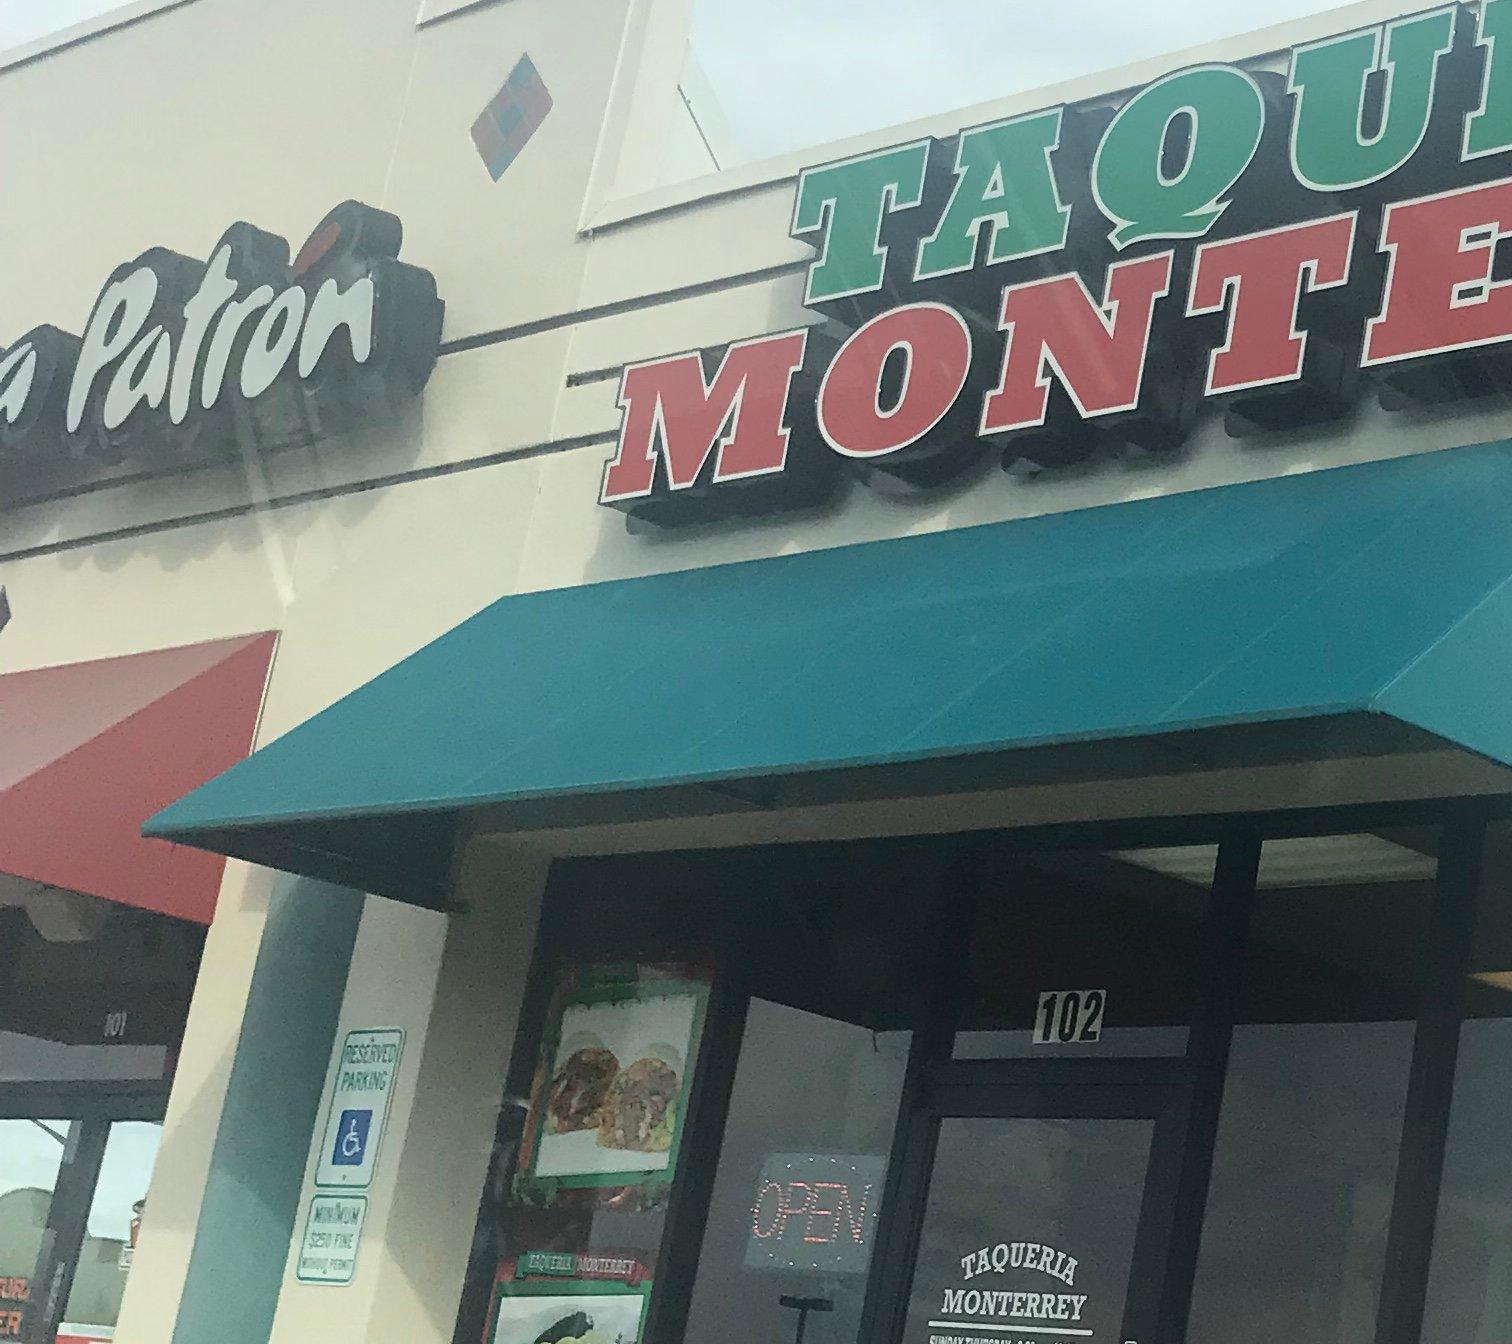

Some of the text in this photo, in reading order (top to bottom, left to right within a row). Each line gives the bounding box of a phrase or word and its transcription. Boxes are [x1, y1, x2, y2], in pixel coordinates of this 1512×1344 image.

[1042, 991, 1102, 1041] 102
[343, 1043, 396, 1064] RESERVED
[340, 1070, 387, 1091] PARKING
[752, 1182, 873, 1244] OPEN
[961, 1242, 1078, 1287] TAQUERIA
[940, 1288, 1087, 1320] MONTERREY
